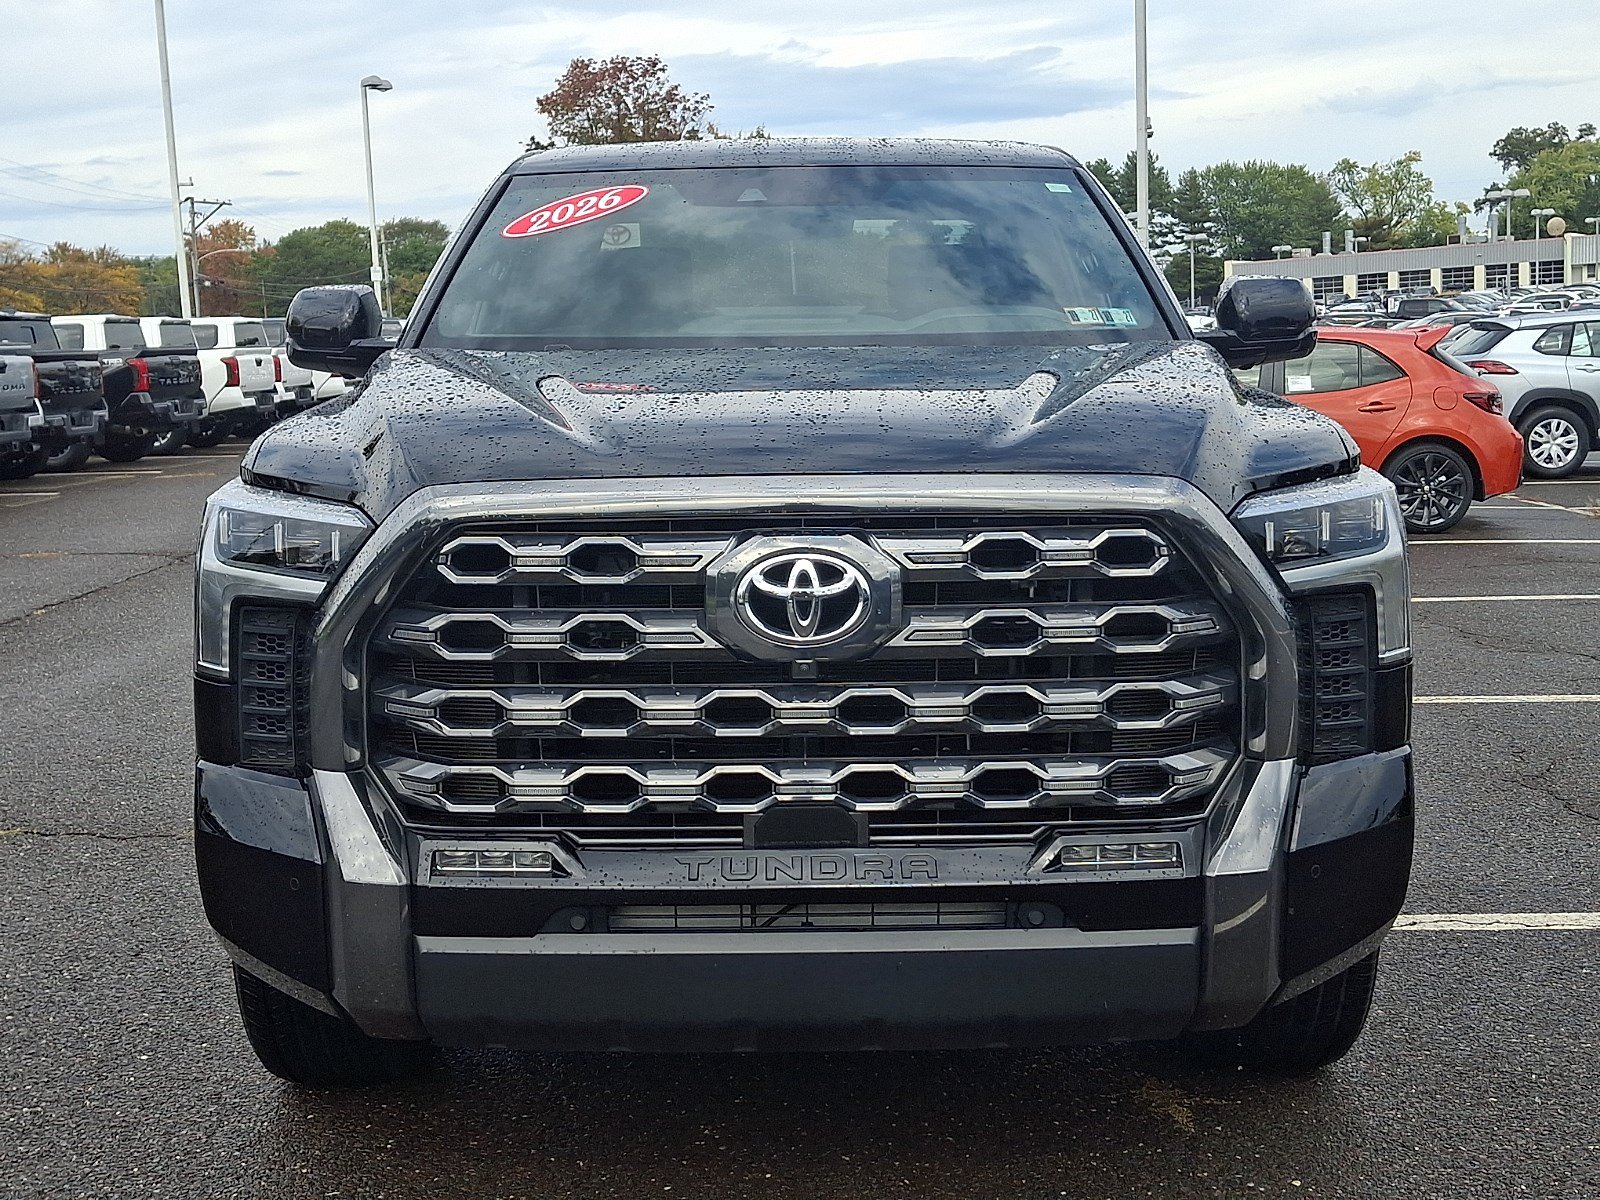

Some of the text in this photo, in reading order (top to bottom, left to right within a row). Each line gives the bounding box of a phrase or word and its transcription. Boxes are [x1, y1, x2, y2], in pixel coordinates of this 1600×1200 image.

[527, 188, 624, 233] 2026
[159, 376, 195, 386] TACOMA
[674, 853, 939, 882] TUNDRA
